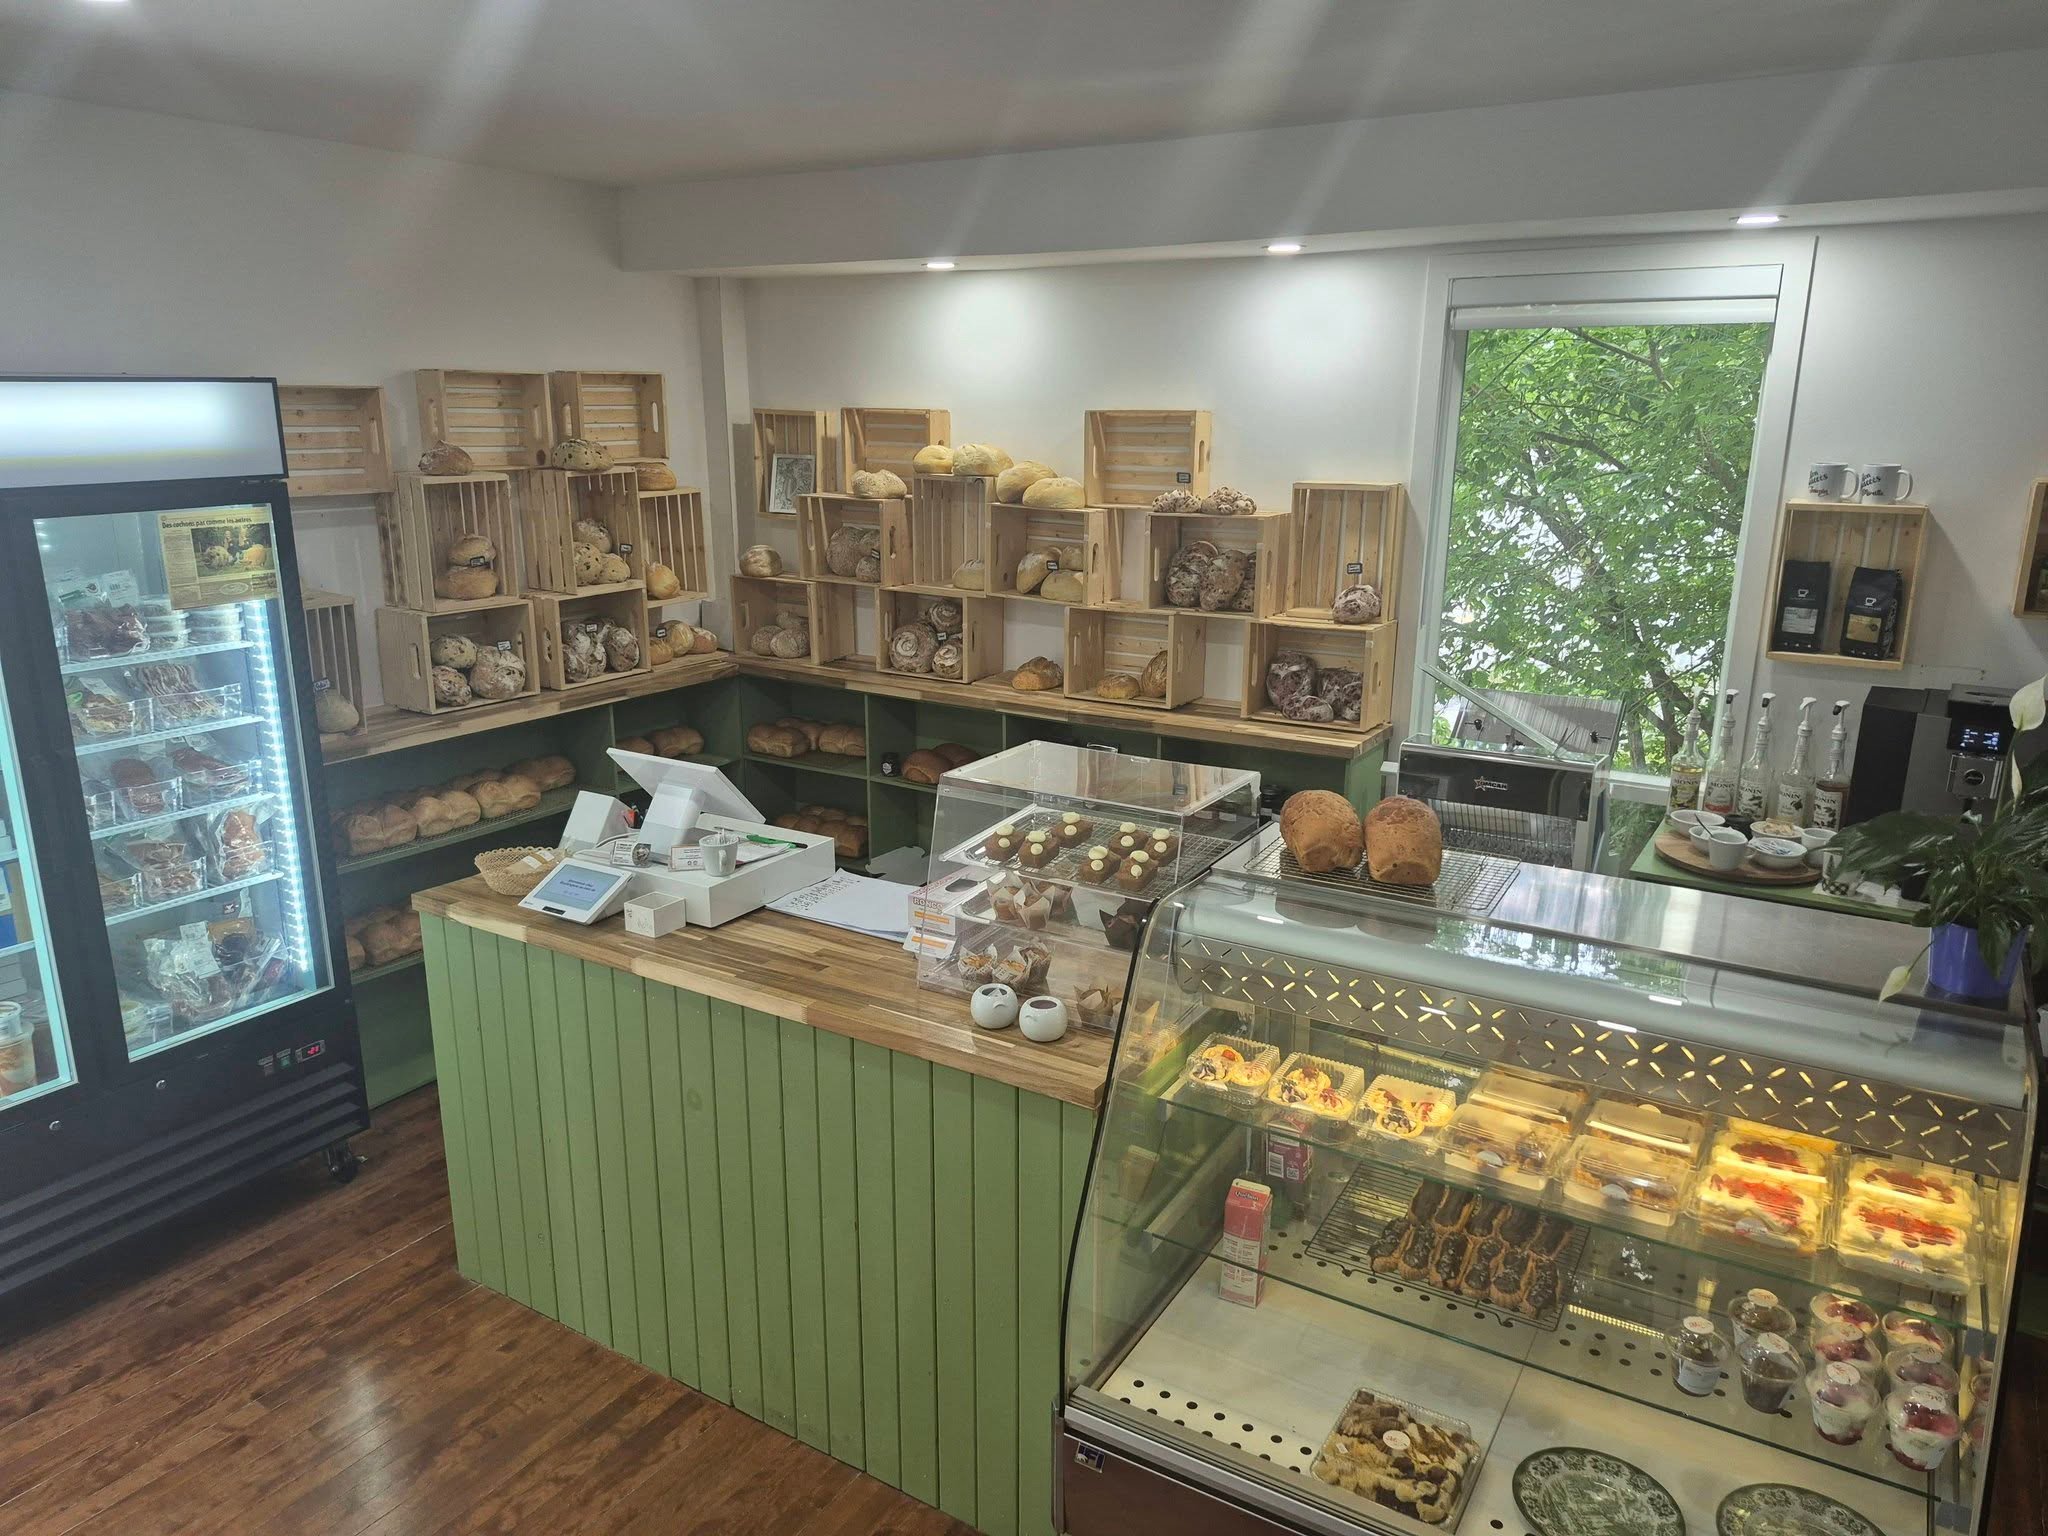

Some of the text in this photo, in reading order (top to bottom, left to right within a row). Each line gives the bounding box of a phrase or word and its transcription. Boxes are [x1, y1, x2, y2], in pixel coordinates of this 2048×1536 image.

[162, 521, 172, 529] Des
[173, 519, 195, 528] cochons
[912, 897, 944, 910] RONCO
